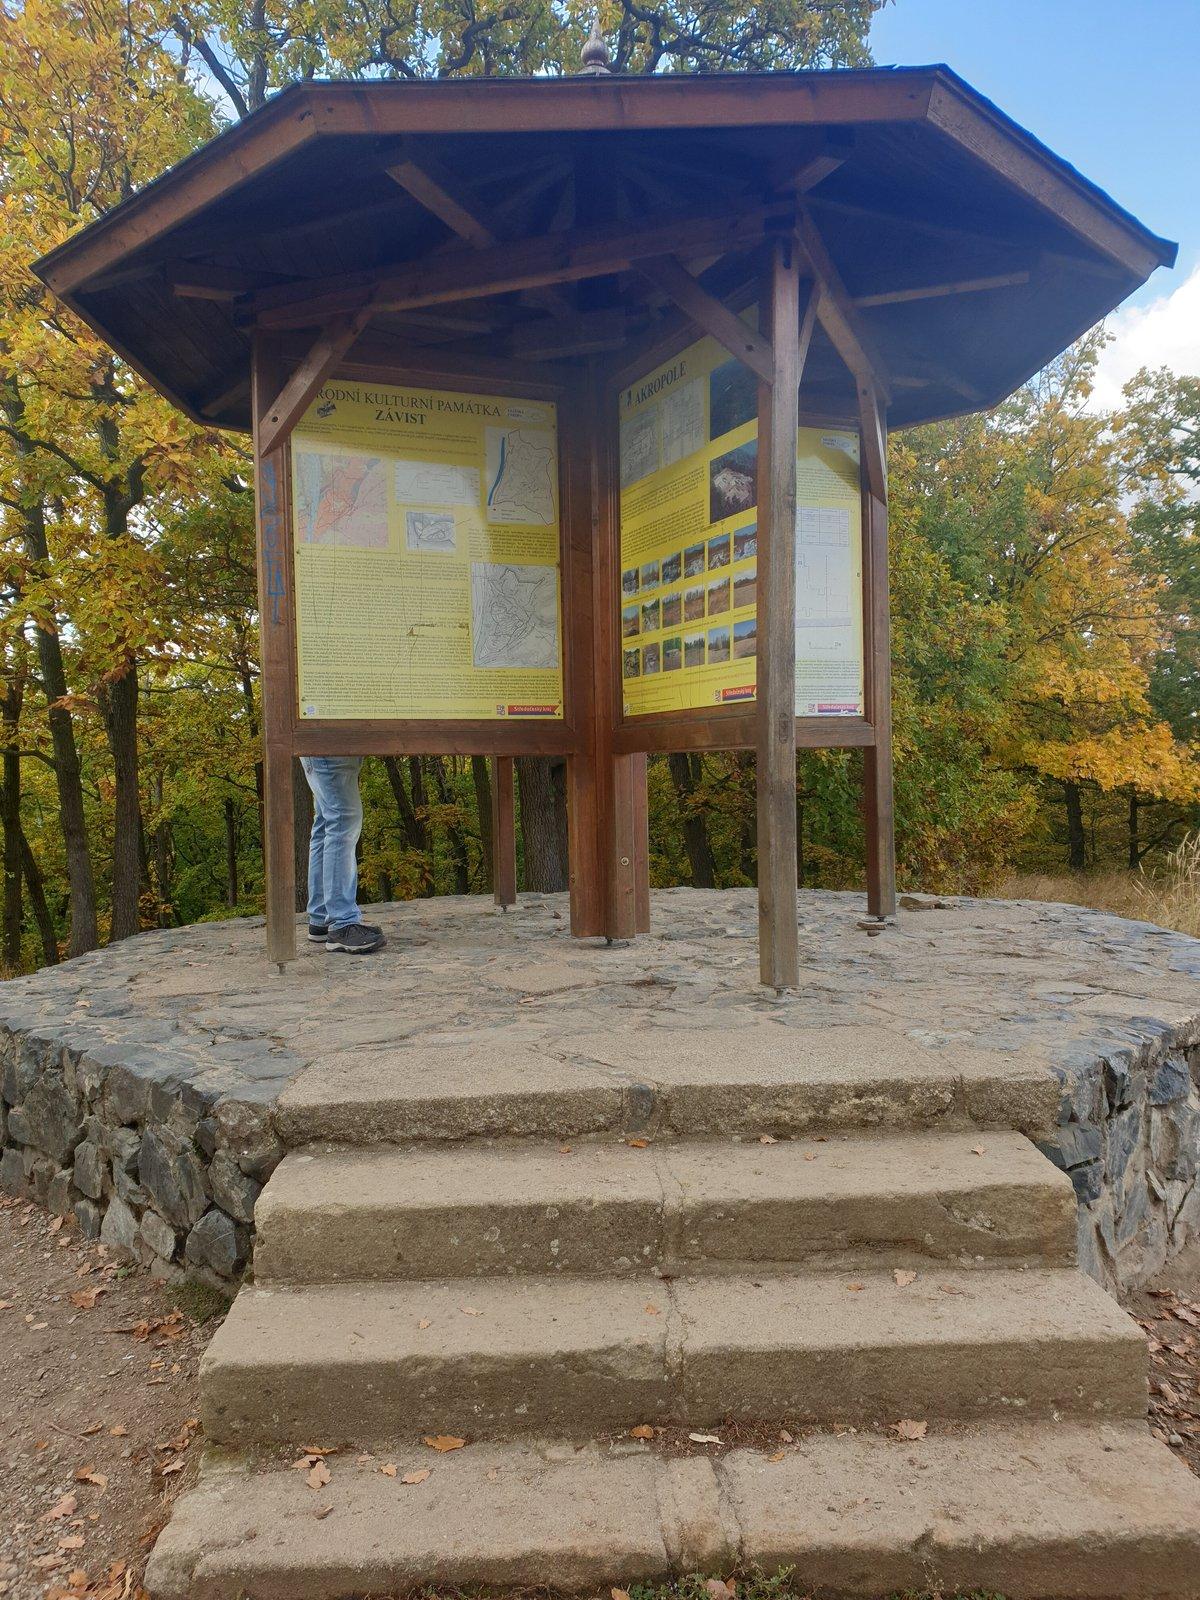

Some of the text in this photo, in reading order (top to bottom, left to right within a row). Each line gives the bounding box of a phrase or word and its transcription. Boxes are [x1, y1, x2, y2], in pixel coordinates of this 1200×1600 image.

[633, 361, 687, 406] AKROPOLE
[316, 388, 361, 403] RODNÍ
[364, 392, 433, 410] KULTURNÍ
[437, 400, 501, 417] PAMÁTKA
[375, 407, 427, 424] ZÁVIST
